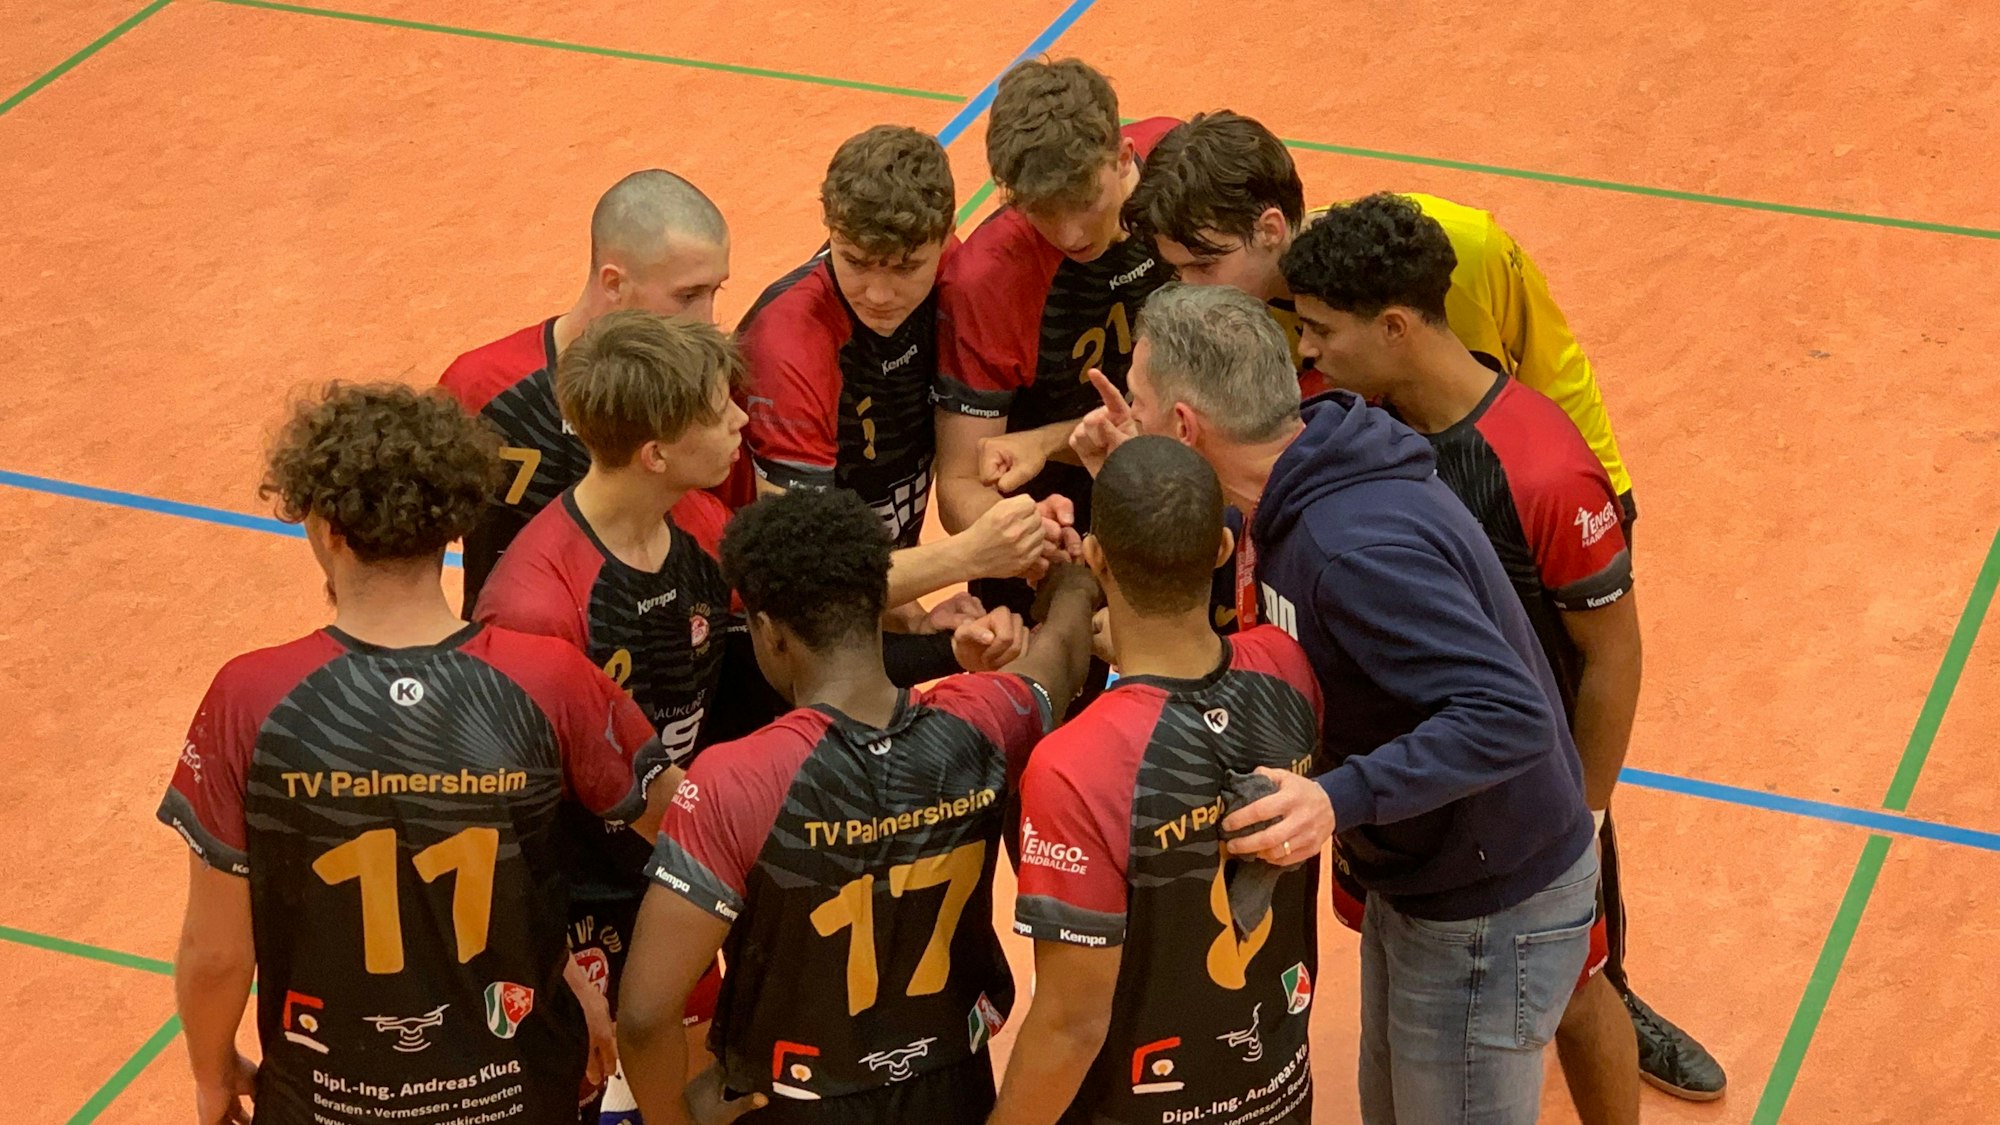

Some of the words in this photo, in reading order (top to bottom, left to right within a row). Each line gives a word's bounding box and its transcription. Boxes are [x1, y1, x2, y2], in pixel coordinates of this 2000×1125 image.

[1109, 258, 1155, 290] Kempa
[882, 344, 918, 375] Kempa
[1072, 302, 1132, 384] 21
[960, 404, 999, 418] Kempa
[637, 588, 677, 616] Kempa
[1586, 588, 1623, 608] Kempa
[281, 772, 323, 798] TV
[331, 769, 527, 797] Palmersheim
[804, 821, 840, 847] TV
[847, 787, 996, 845] Palmersheim
[1154, 814, 1187, 850] TV
[172, 817, 203, 854] Kempa
[655, 866, 690, 893] Kempa
[1021, 853, 1088, 876] ANDBALL.DE
[312, 827, 499, 974] 11
[809, 840, 986, 1017] 17
[1060, 929, 1107, 947] Kempa
[313, 1069, 395, 1101] Dipl.-Ing.
[400, 1073, 478, 1097] Andreas
[480, 1059, 521, 1083] Kluß
[1162, 1096, 1243, 1124] Dipl.-Ing.
[1245, 1060, 1296, 1102] Andreas
[314, 1092, 363, 1116] Beraten
[374, 1101, 450, 1119] Vermessen
[461, 1084, 523, 1109] Bewerten
